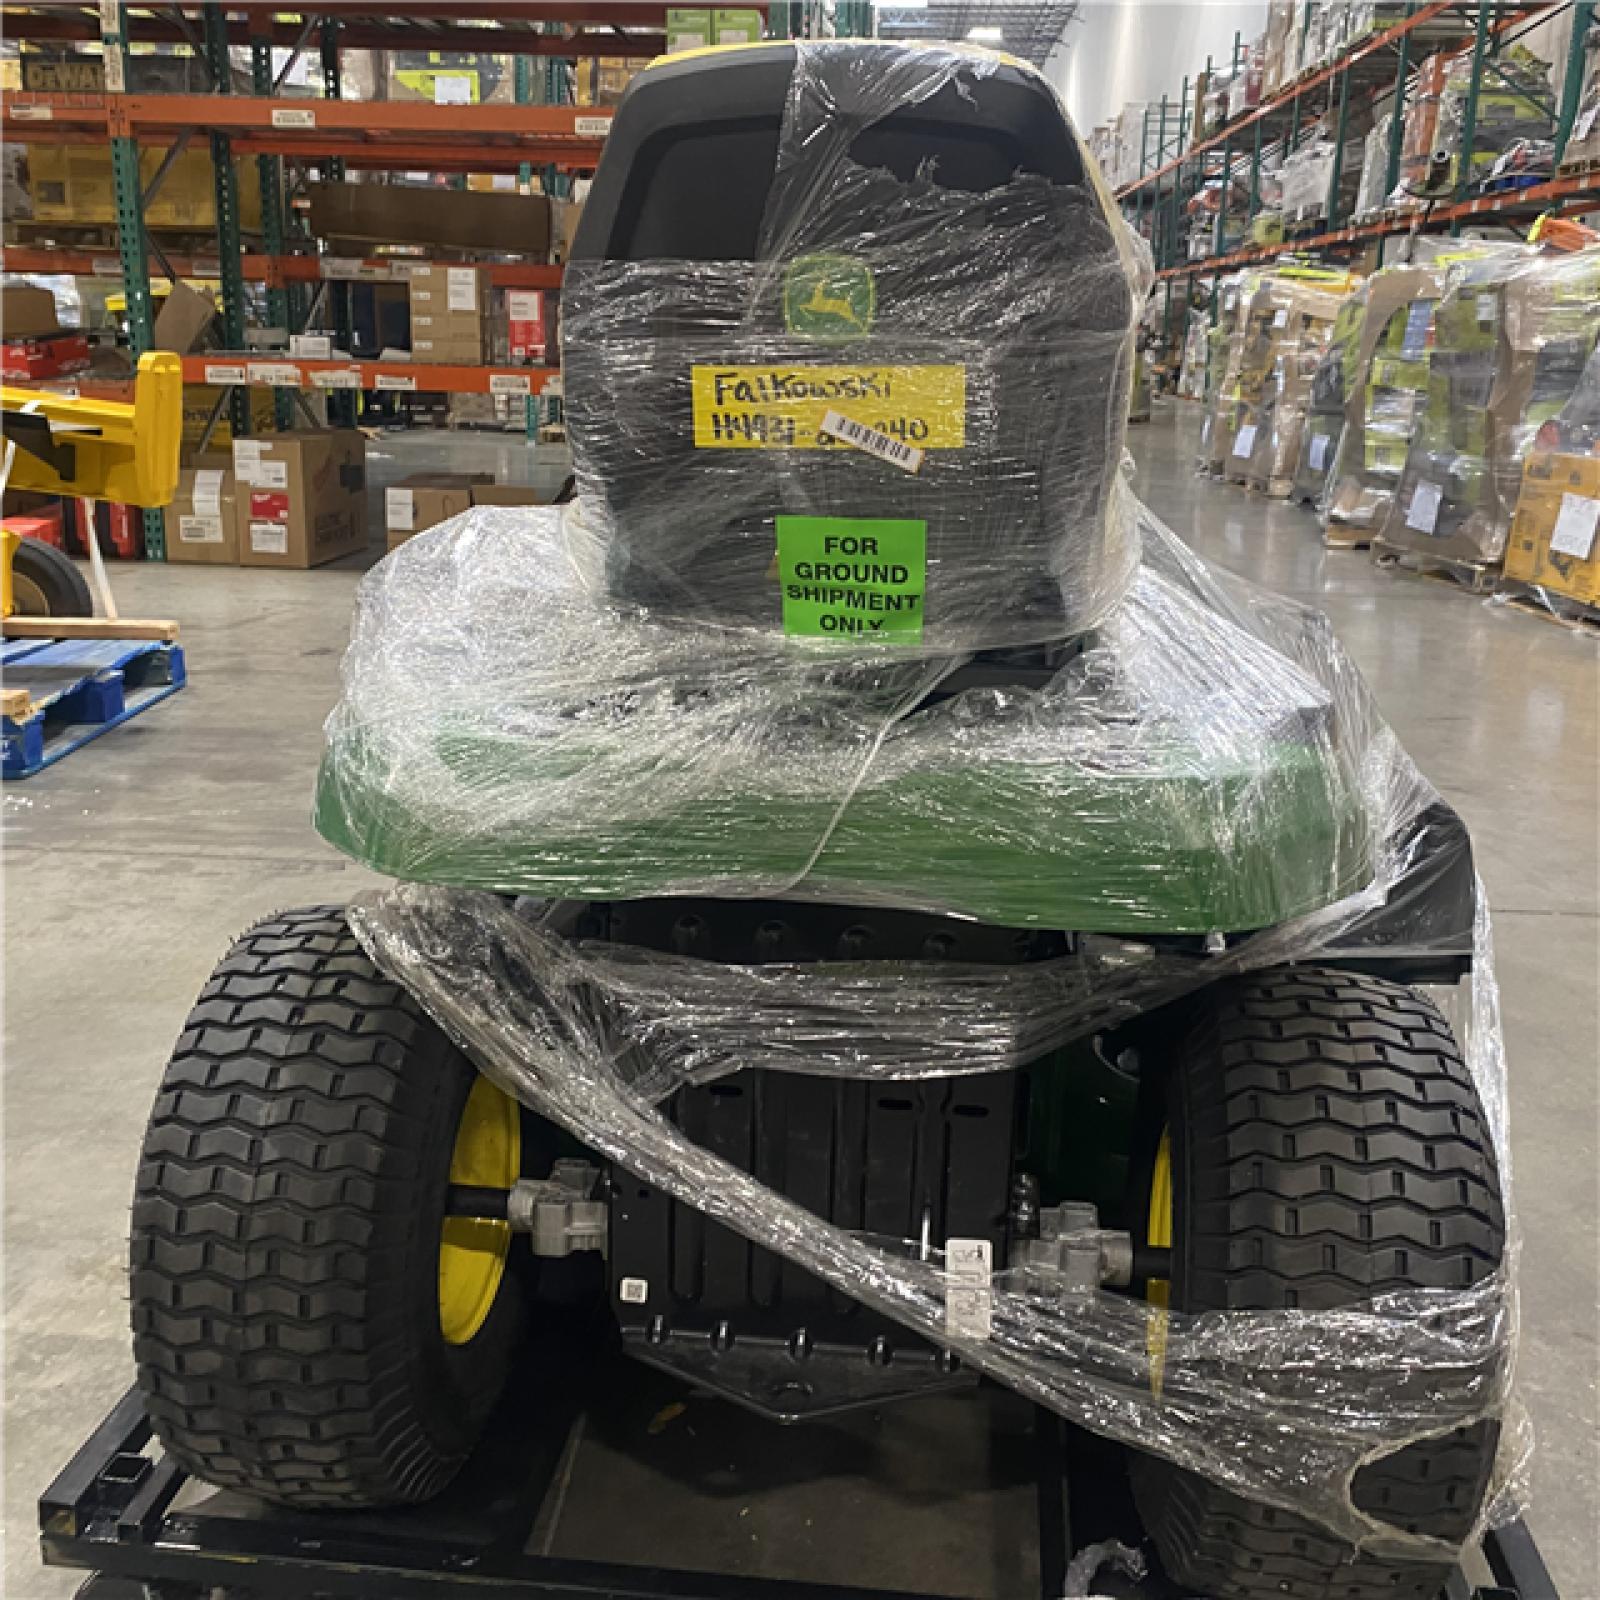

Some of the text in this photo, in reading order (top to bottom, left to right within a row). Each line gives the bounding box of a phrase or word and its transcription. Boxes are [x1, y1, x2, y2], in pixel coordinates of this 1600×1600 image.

[824, 536, 878, 555] FOR
[795, 562, 909, 583] GROUND
[787, 584, 921, 611] SHIPMENT
[820, 614, 885, 635] ONLY
